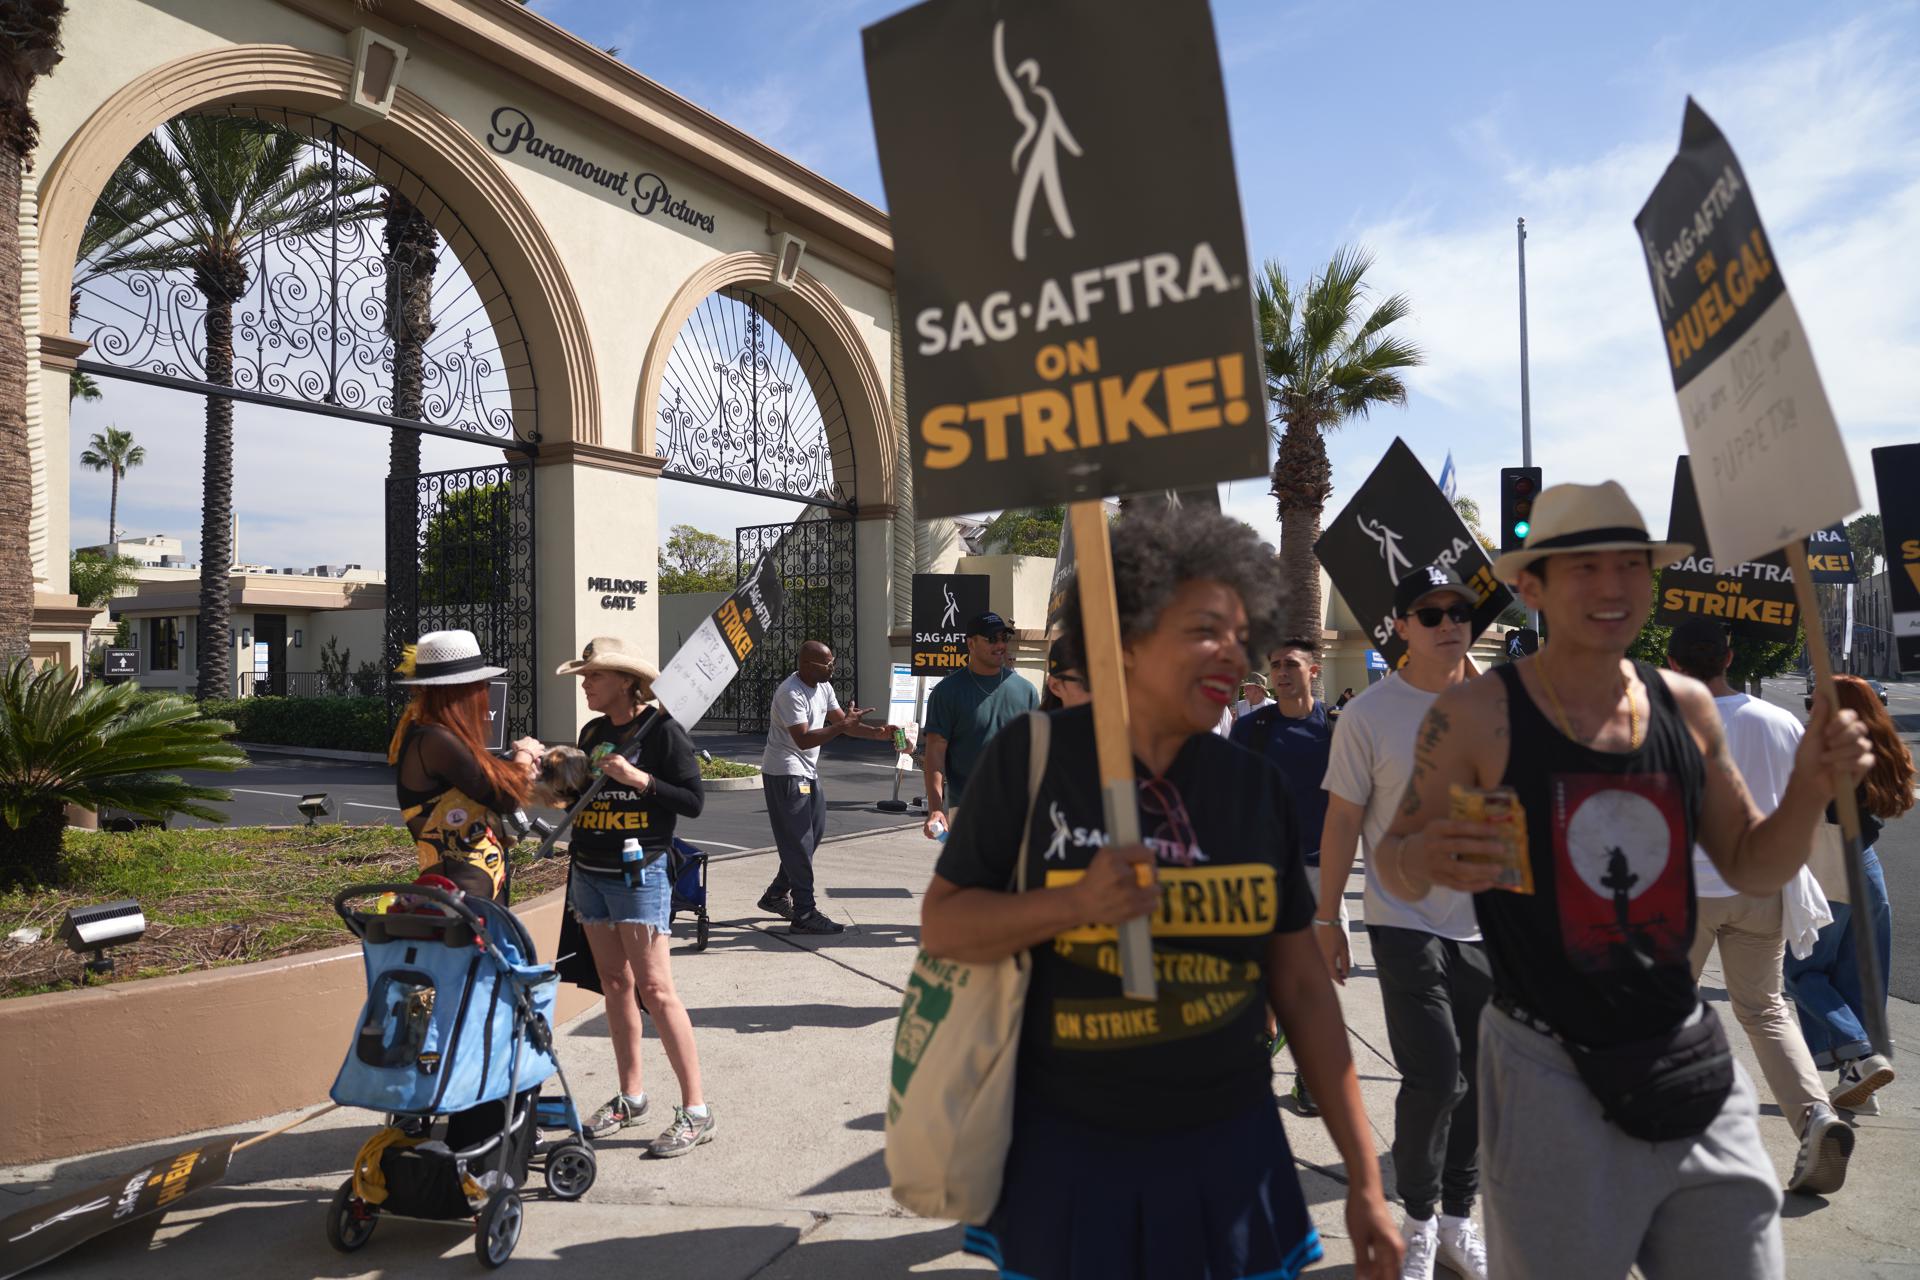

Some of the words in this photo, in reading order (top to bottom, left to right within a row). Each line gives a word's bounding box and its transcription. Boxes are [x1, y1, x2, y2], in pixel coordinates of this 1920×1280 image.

[486, 107, 628, 196] Paramount
[631, 173, 715, 233] Pictures
[1667, 228, 1772, 369] HUELGA!
[1035, 337, 1100, 381] ON
[921, 353, 1249, 470] STRIKE!
[588, 577, 648, 594] MELROSE
[1425, 566, 1448, 584] LA
[1670, 556, 1795, 583] SAGAFTRA
[600, 595, 636, 611] GATE
[1716, 580, 1743, 593] ON
[1664, 588, 1796, 626] STRIKE!
[717, 599, 754, 662] STRIKE!
[942, 645, 957, 653] ON
[593, 802, 610, 810] ON
[1161, 876, 1270, 925] TRIKE
[1055, 1012, 1081, 1039] ON
[1085, 1008, 1160, 1041] STRIKE
